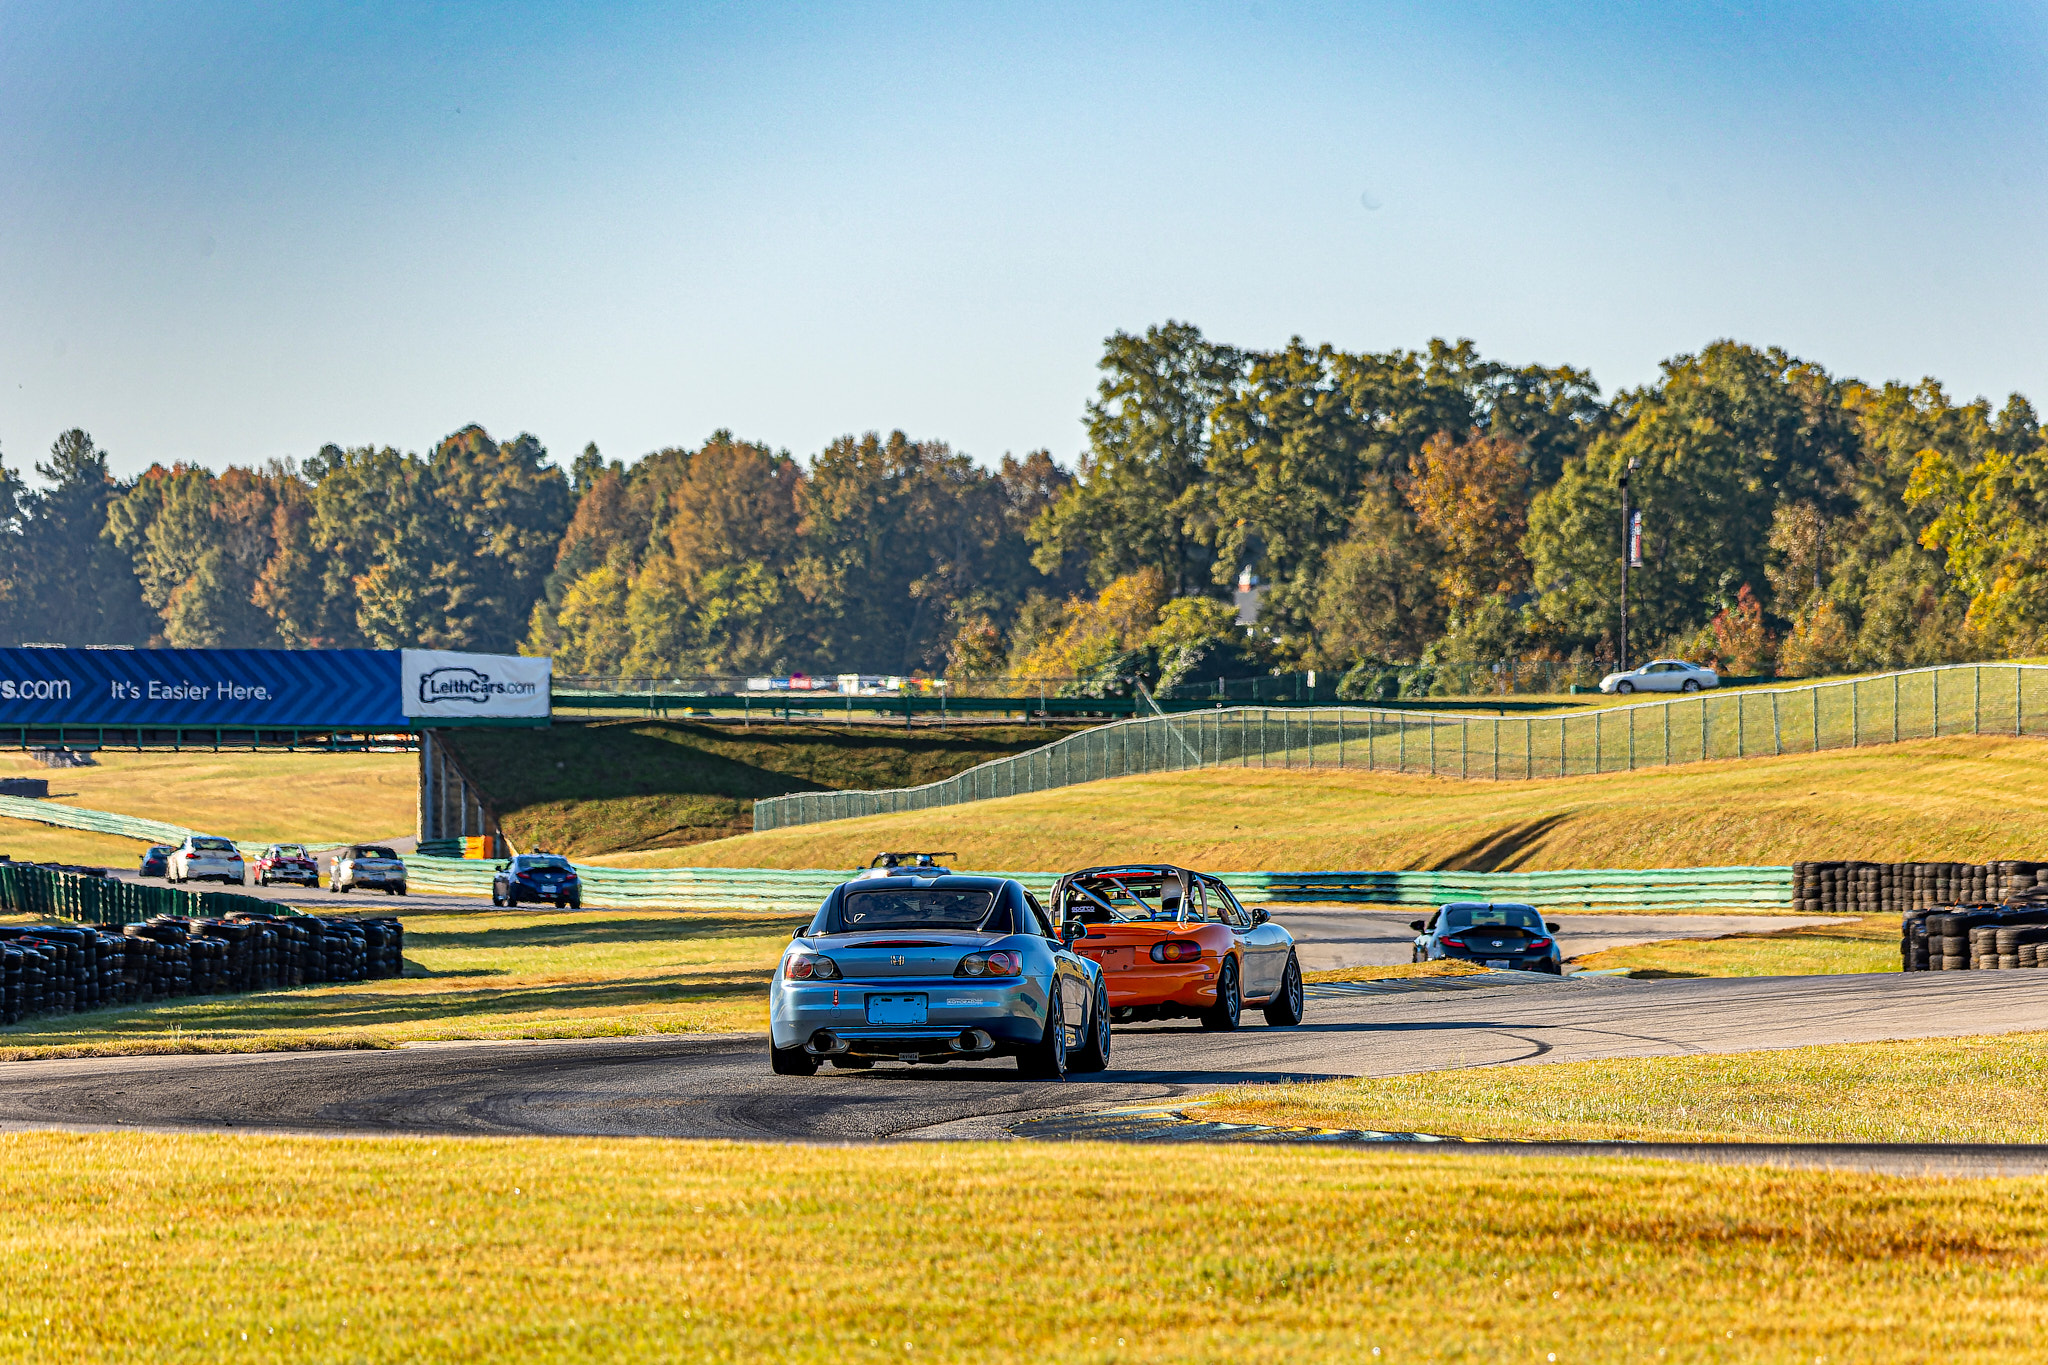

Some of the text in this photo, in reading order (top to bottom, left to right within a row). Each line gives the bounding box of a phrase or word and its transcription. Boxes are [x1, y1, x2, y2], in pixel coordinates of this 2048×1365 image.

[0, 679, 273, 700] s.com It's Easier Here.
[431, 679, 535, 694] LeithCars.com
